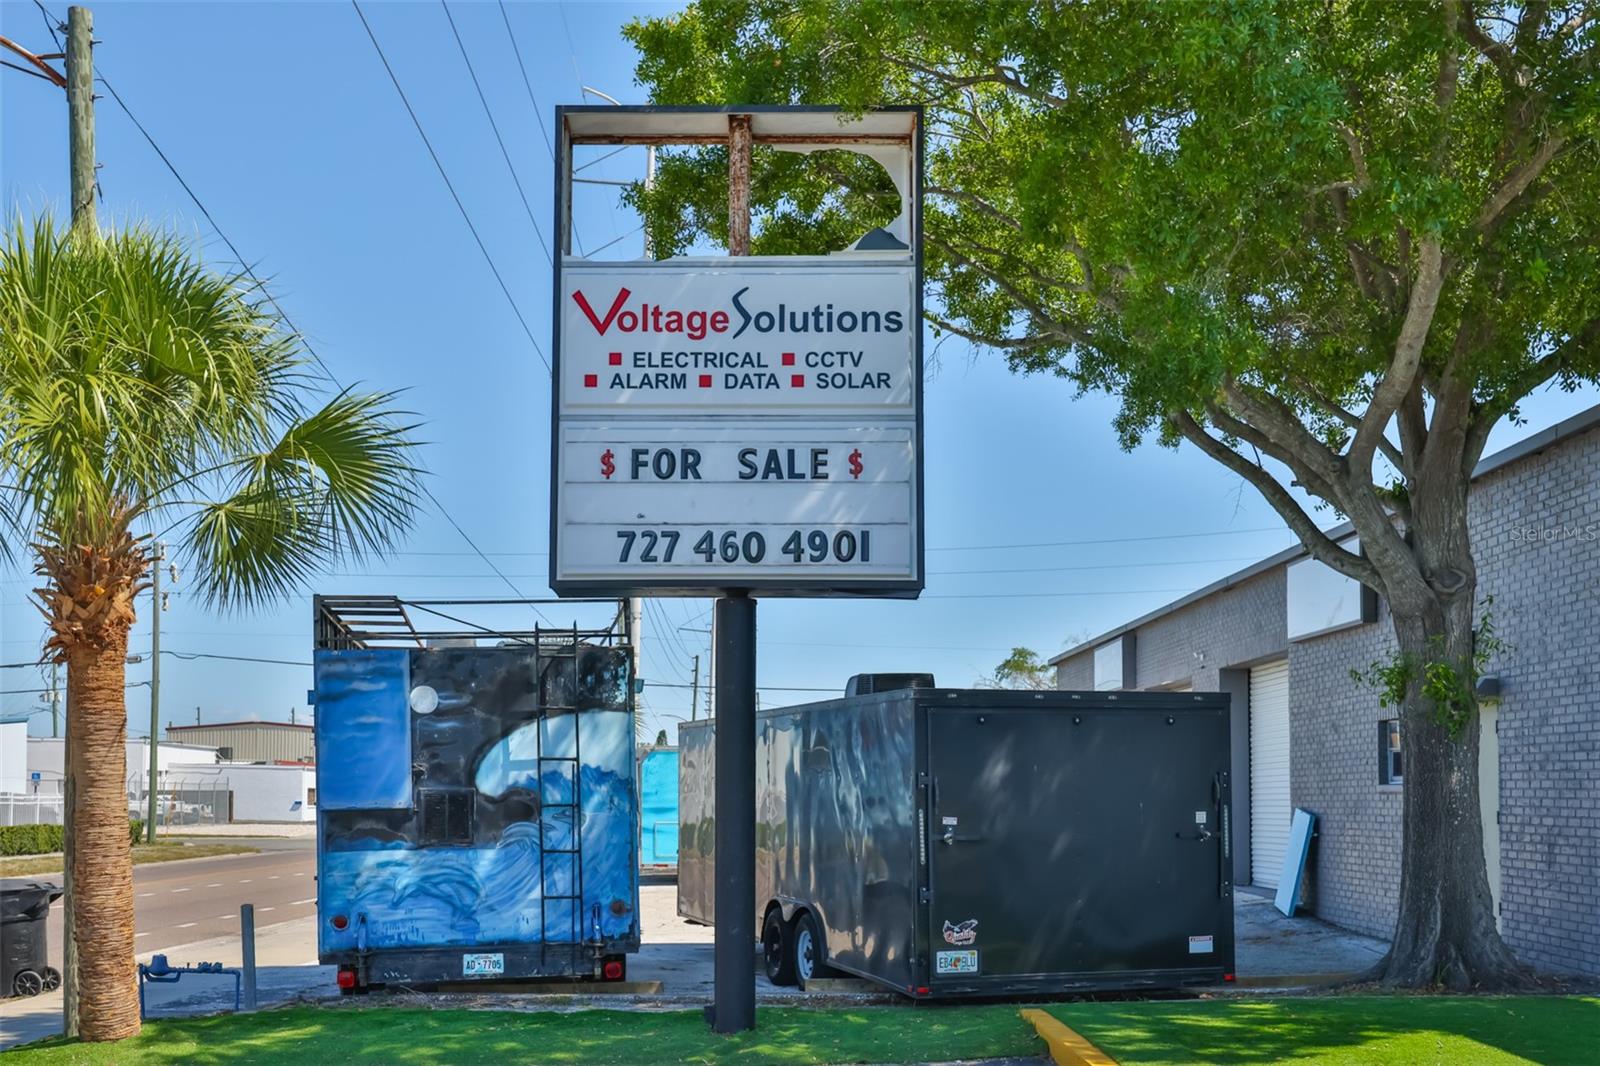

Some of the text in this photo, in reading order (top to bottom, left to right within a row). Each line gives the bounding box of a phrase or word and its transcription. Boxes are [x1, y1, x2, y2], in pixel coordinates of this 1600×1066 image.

[572, 287, 903, 340] Voltage Solutions
[633, 351, 863, 368] ELECTRICAL CCTV
[609, 373, 892, 389] ALARM DATA SOLAR
[600, 448, 864, 480] $ FOR SALE $
[617, 530, 870, 563] 727 460 4901
